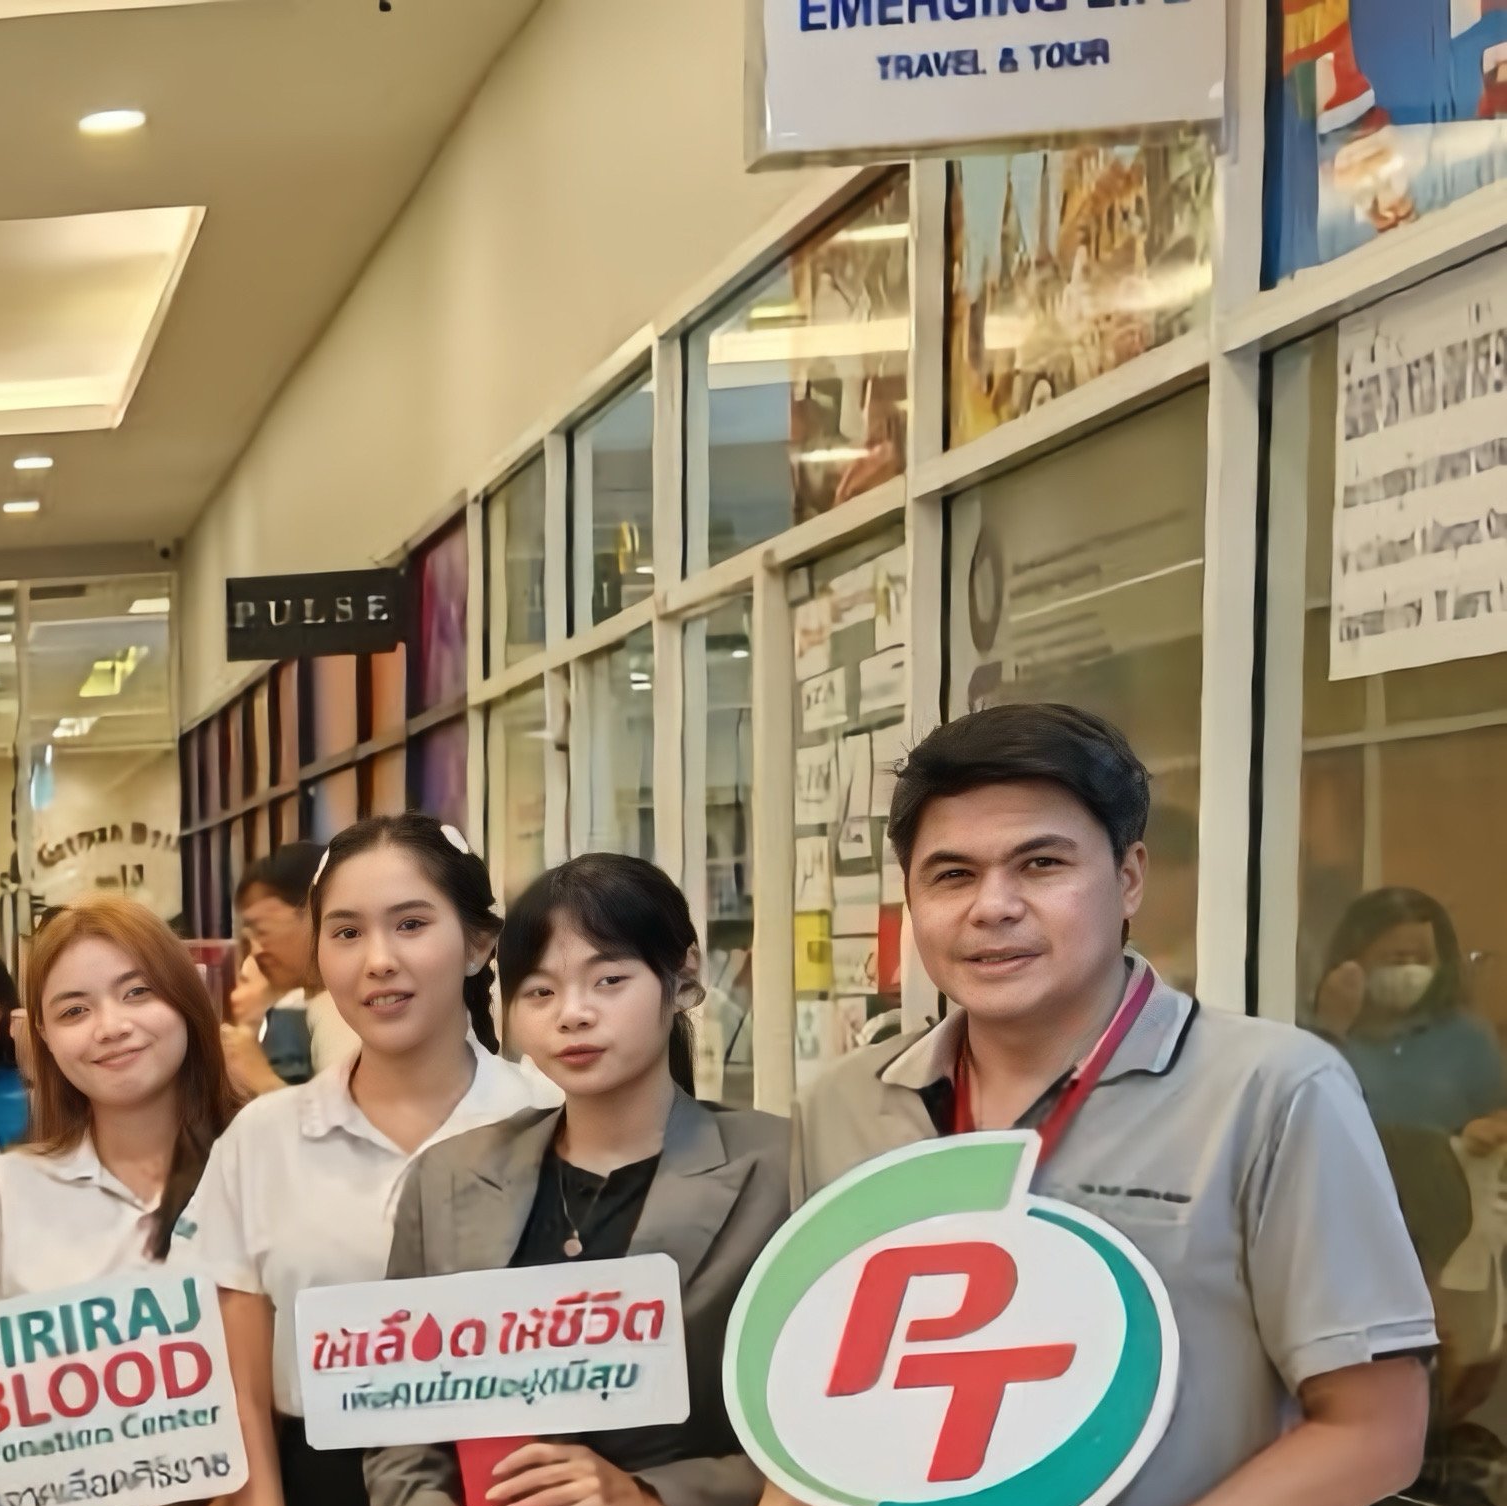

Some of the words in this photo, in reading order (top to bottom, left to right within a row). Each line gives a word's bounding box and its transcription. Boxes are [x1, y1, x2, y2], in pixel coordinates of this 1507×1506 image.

[877, 49, 987, 80] TRAVEL
[1030, 38, 1110, 71] TOUR
[233, 595, 389, 628] PULSE
[498, 1290, 666, 1355] ให้ชีวิต
[825, 1241, 1078, 1484] PT
[120, 1404, 222, 1440] Center
